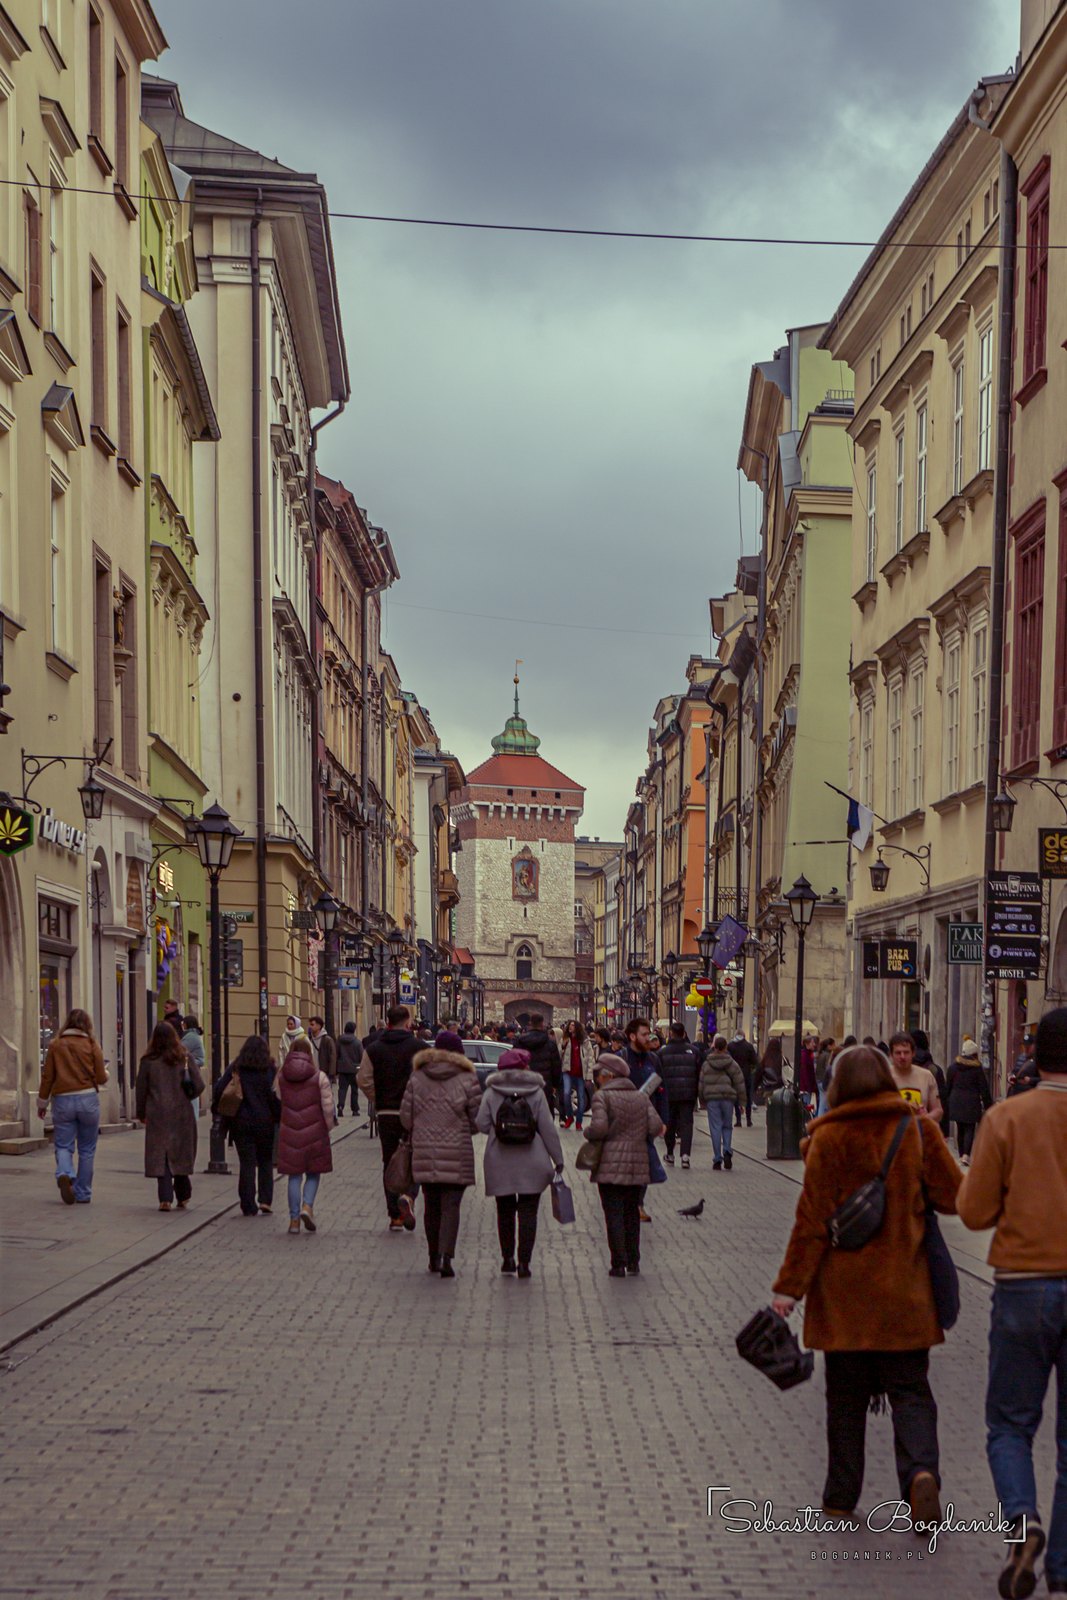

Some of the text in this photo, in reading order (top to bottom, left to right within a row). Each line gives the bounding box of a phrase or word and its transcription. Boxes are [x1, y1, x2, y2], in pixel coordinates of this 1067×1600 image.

[989, 881, 1008, 892] VIVA
[1019, 884, 1041, 893] PINTA
[951, 927, 983, 942] TAK
[887, 948, 909, 961] BAZA
[887, 959, 902, 972] PUB
[999, 968, 1026, 979] HOSTEL
